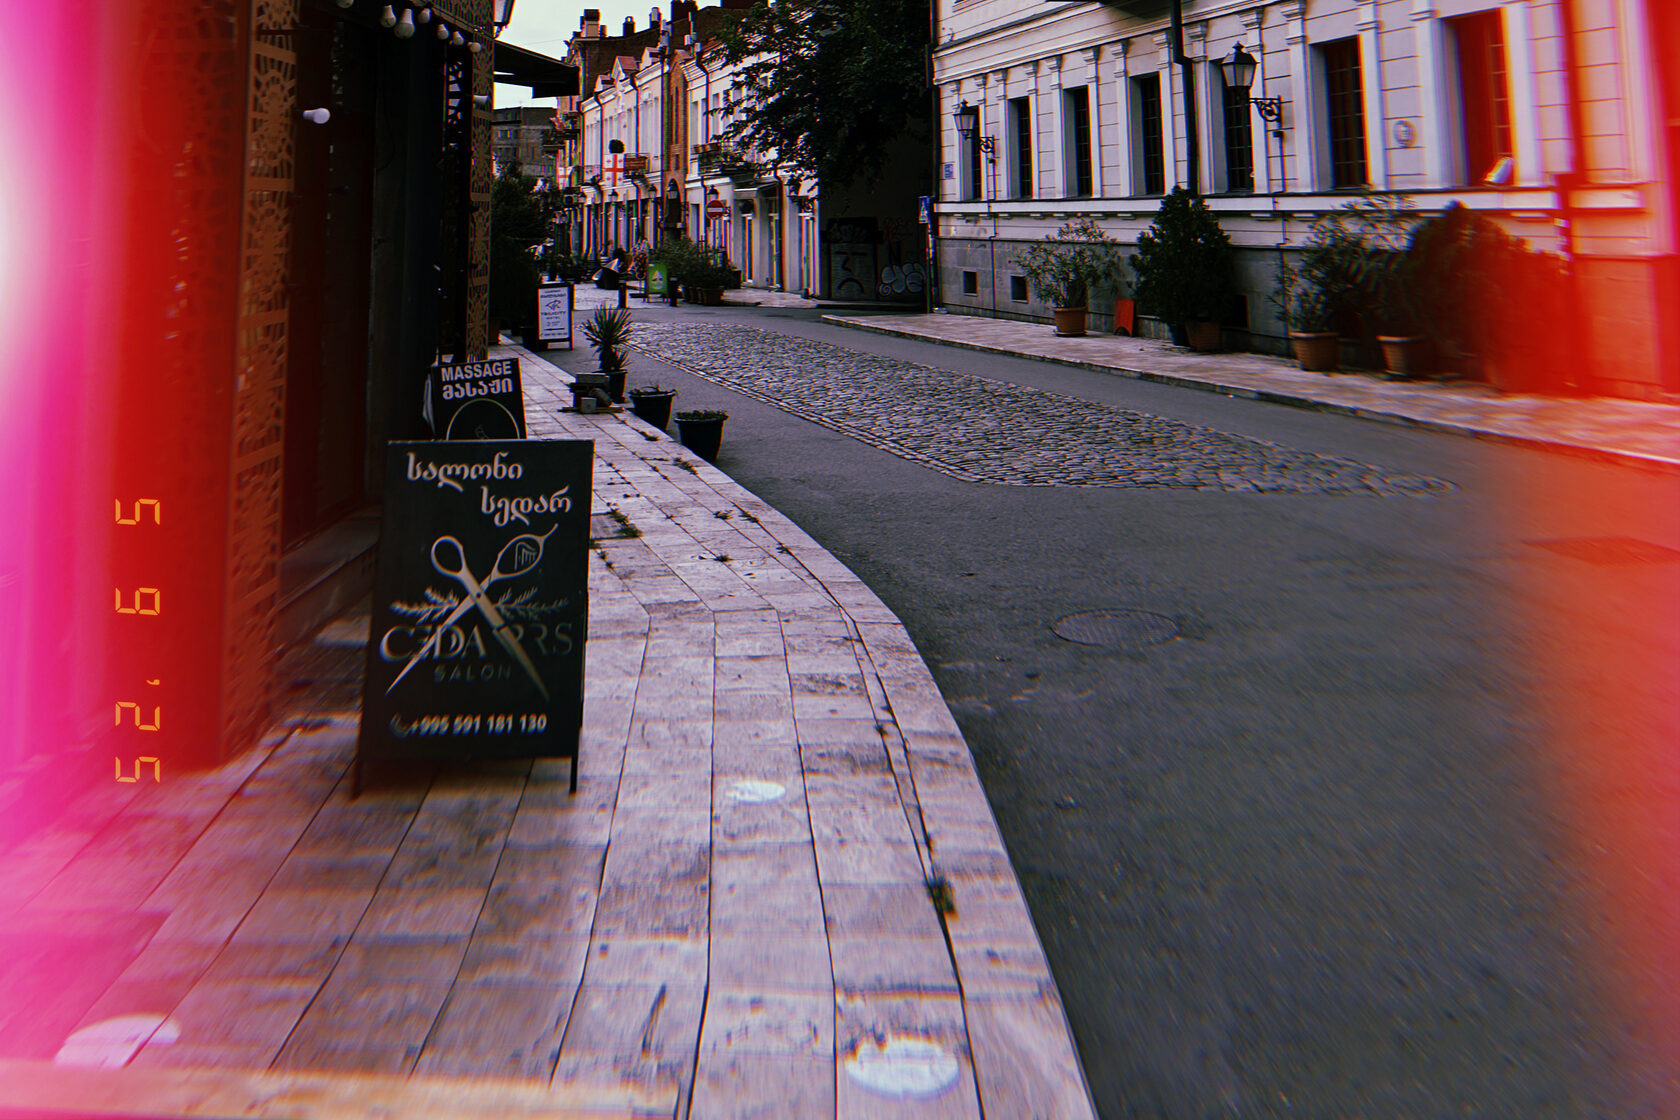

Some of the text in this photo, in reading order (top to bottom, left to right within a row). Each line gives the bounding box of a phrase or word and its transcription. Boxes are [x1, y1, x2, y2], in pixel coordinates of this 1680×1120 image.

[441, 361, 512, 382] MASSAGE
[442, 378, 513, 400] მასაჟი
[407, 452, 523, 493] სალონი
[434, 663, 511, 683] SALON
